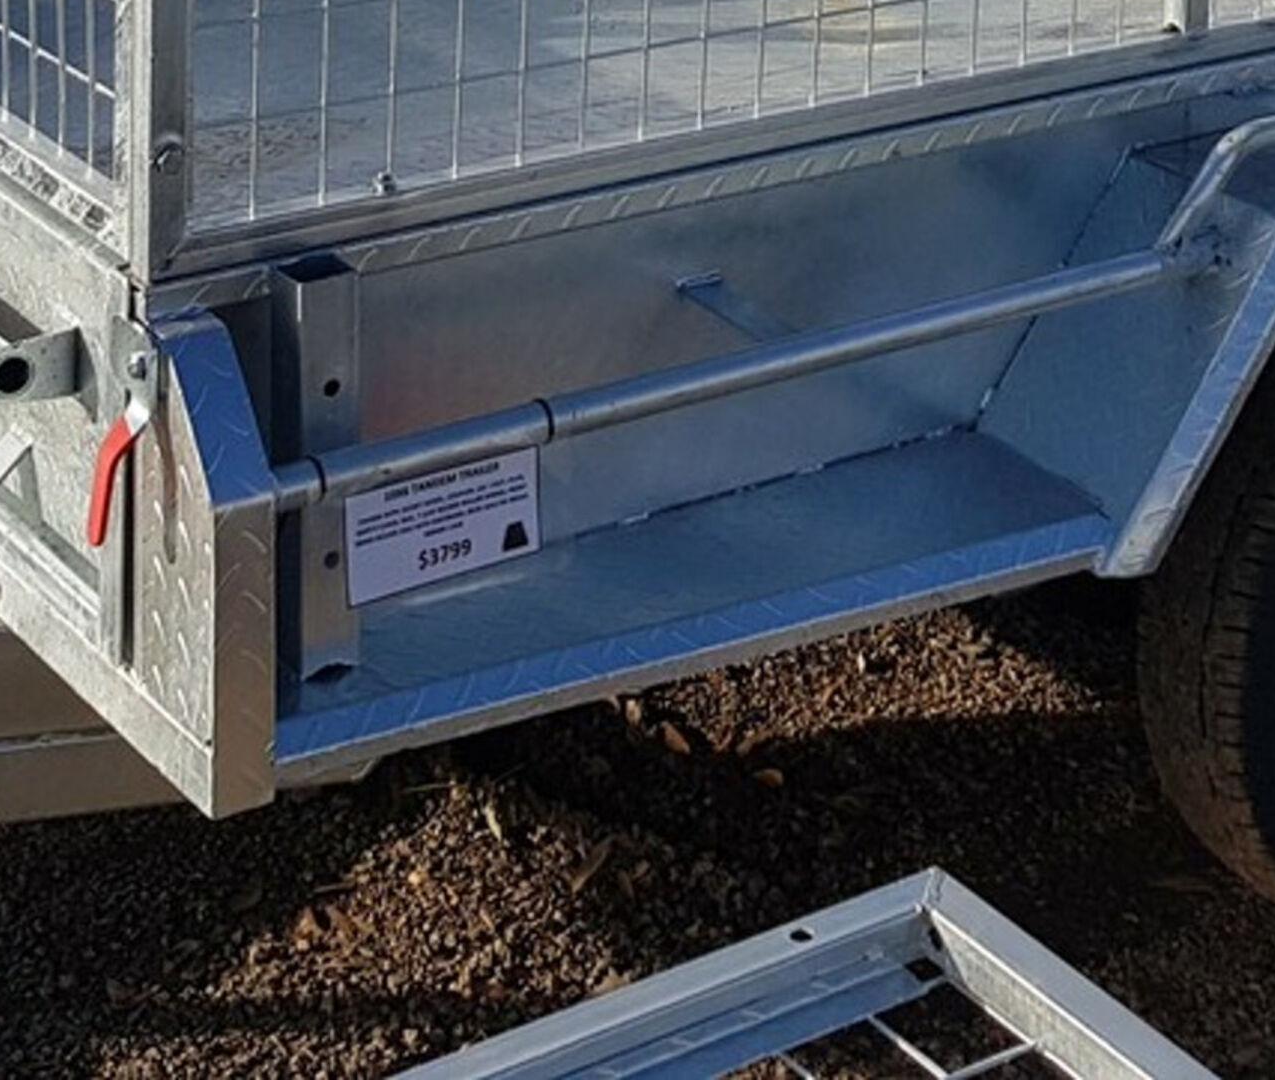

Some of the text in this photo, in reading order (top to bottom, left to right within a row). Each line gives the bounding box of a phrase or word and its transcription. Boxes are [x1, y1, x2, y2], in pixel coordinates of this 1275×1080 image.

[411, 474, 457, 495] TANDEM
[459, 462, 499, 480] TRAILER
[418, 539, 472, 571] $3799
